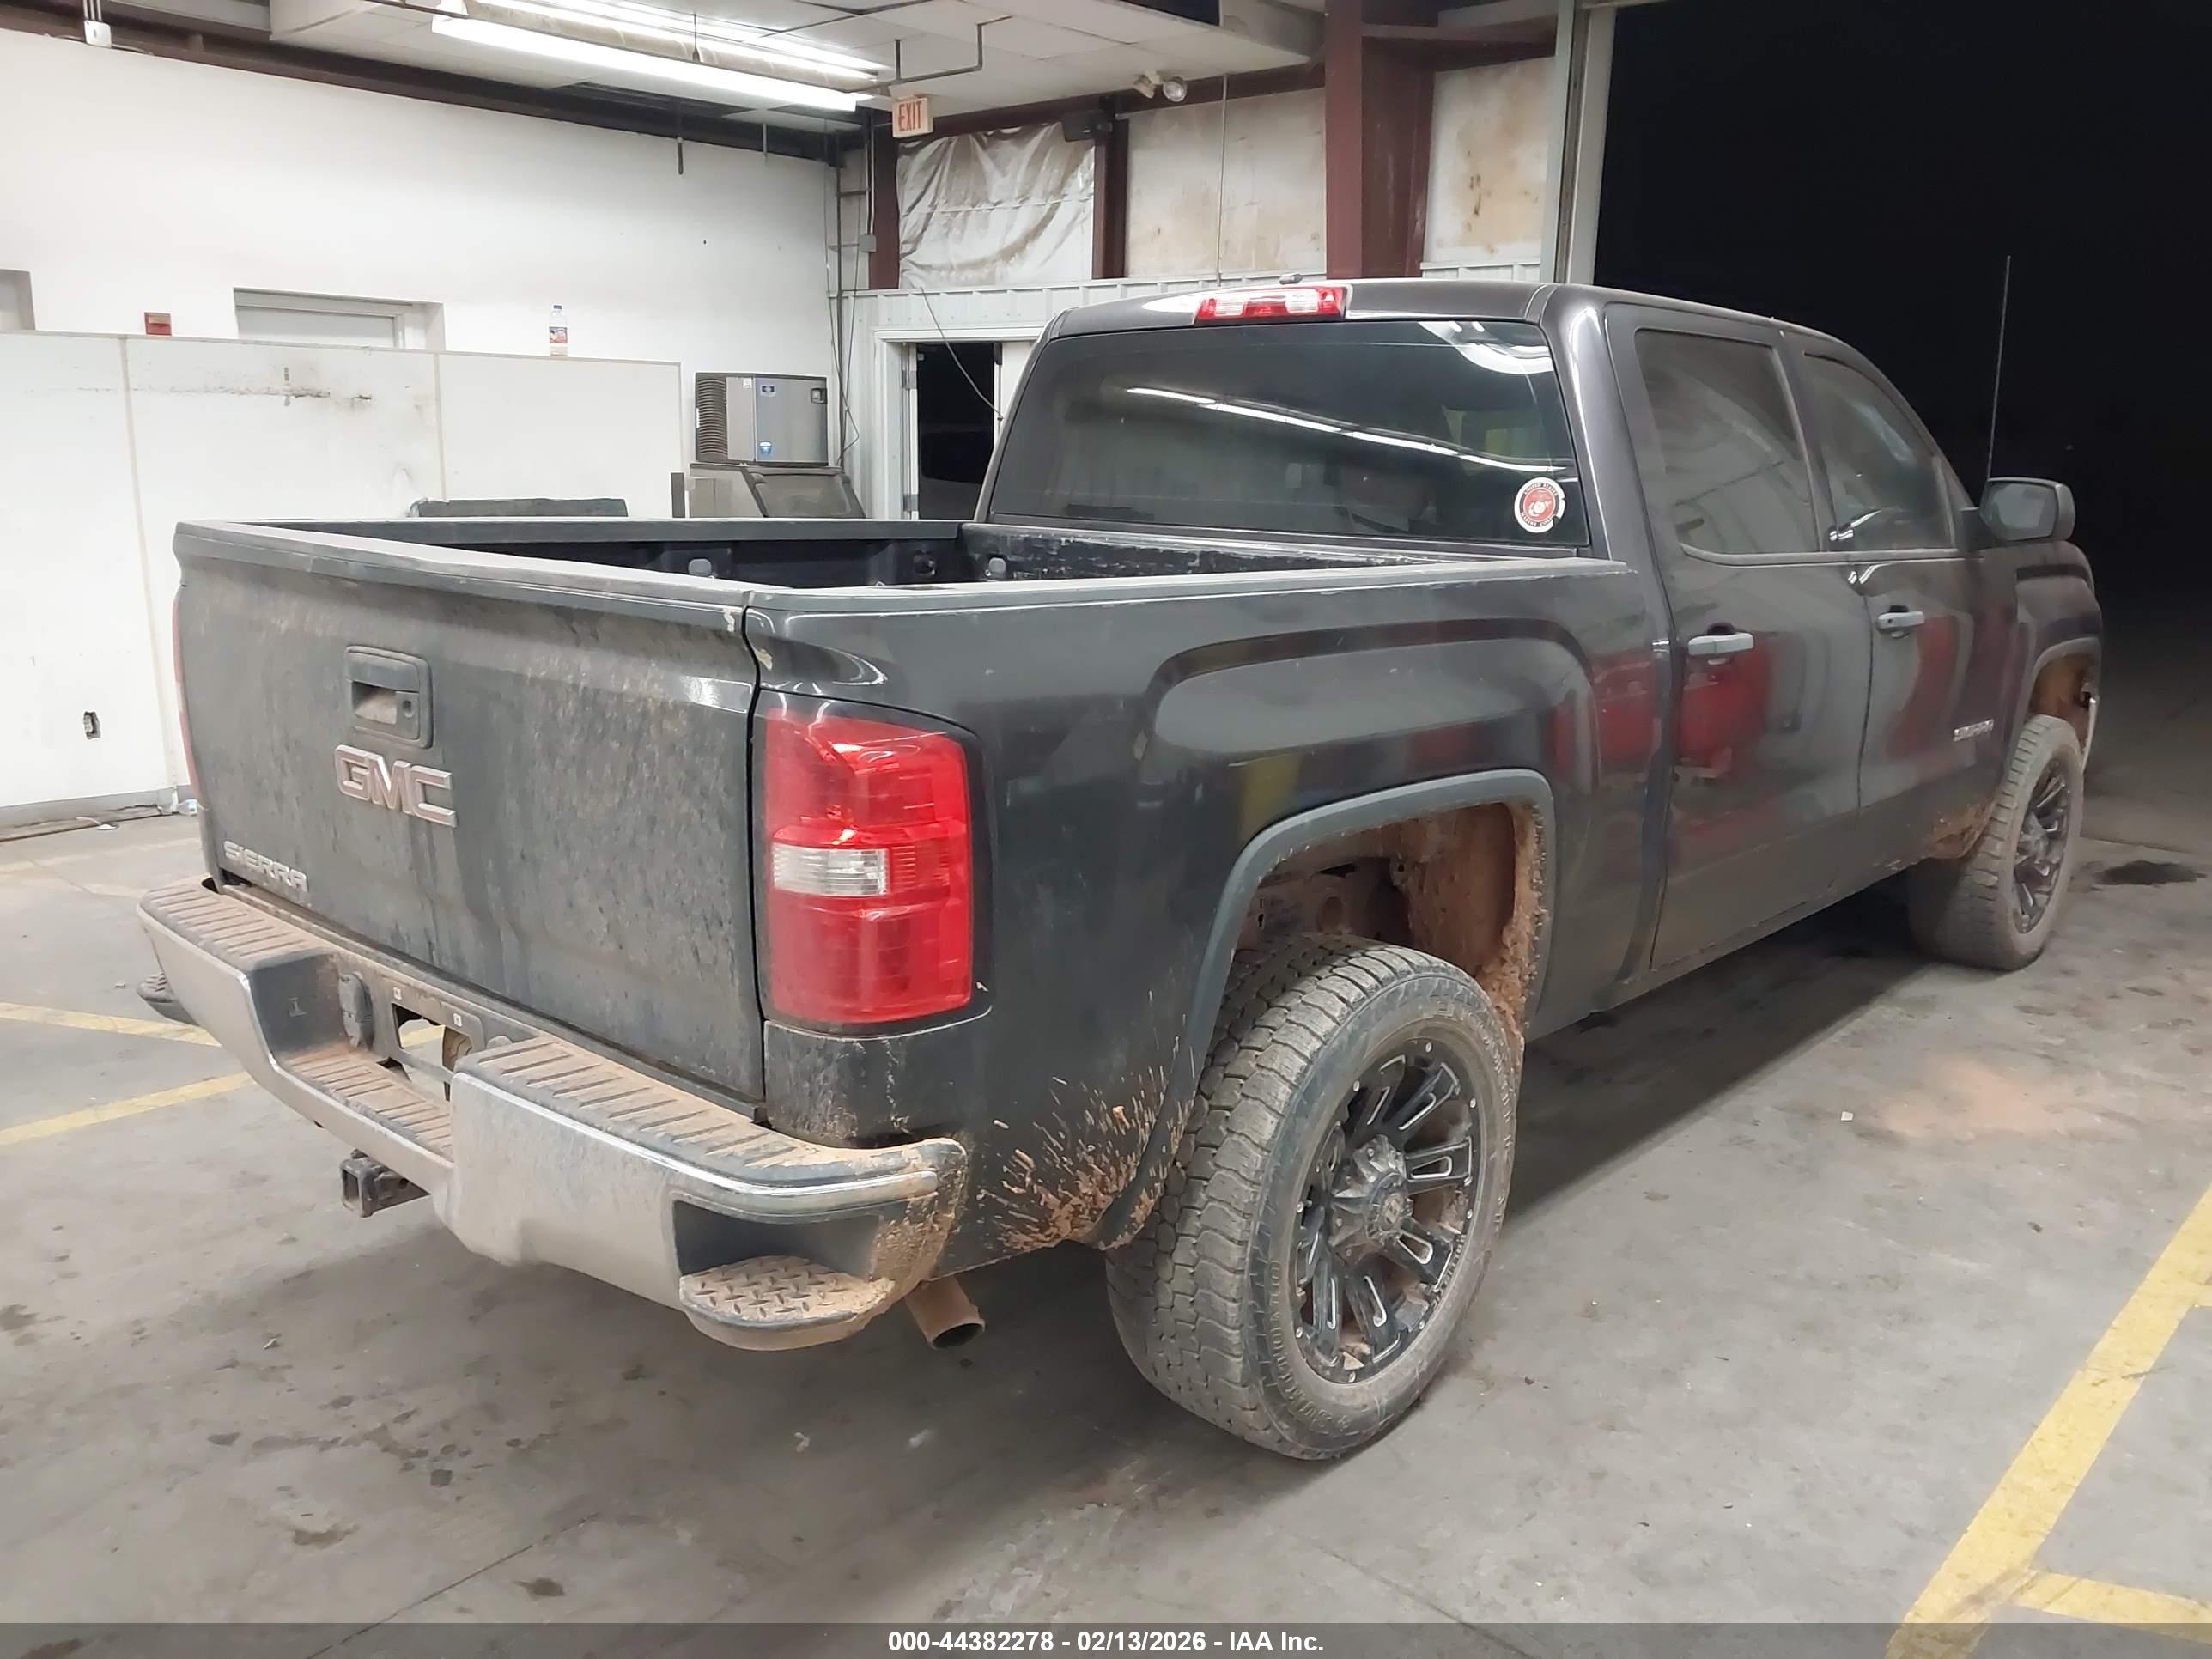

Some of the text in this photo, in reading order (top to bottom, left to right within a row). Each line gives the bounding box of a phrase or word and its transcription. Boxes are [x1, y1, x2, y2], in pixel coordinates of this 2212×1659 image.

[898, 100, 922, 132] EXIT
[334, 744, 458, 829] GMC
[222, 839, 309, 894] SIERRA
